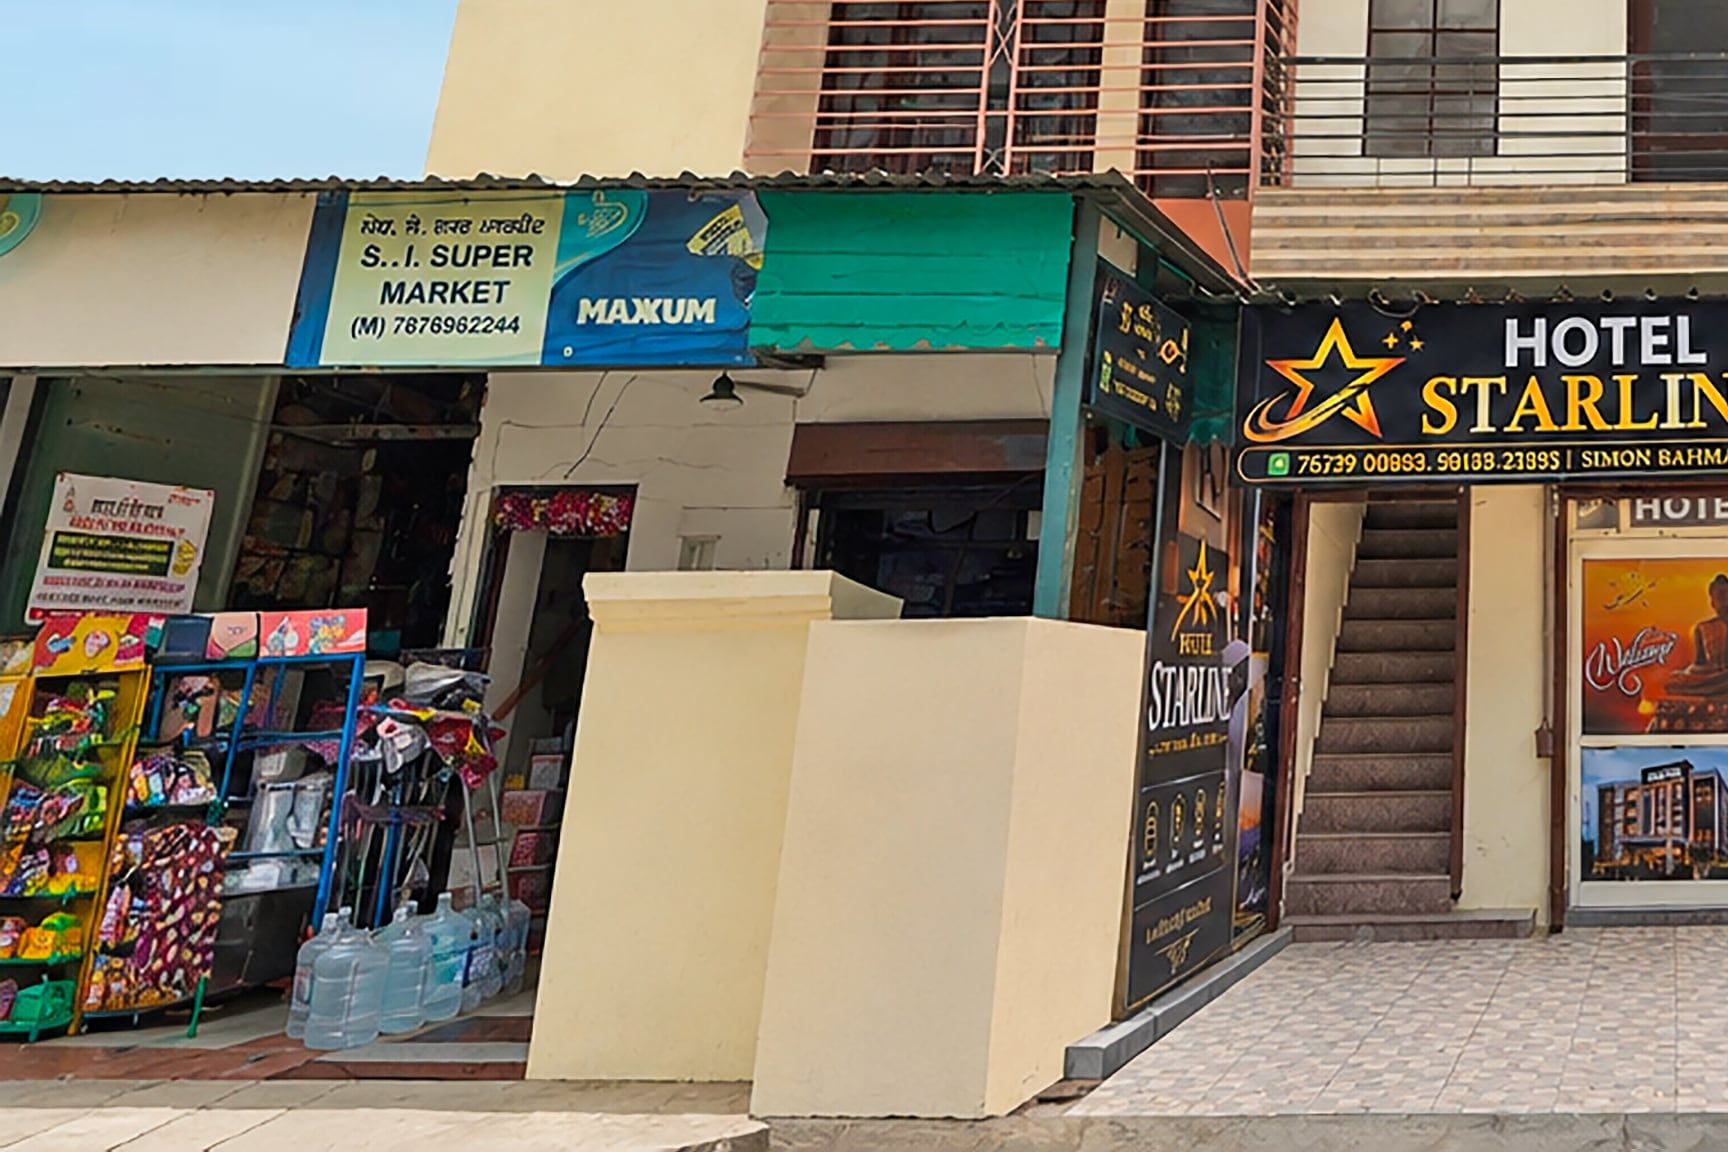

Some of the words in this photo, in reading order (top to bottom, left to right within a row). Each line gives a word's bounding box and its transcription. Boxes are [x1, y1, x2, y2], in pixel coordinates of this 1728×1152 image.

[430, 244, 534, 268] SUPER
[380, 280, 511, 305] MARKET
[351, 316, 386, 340] (M)
[1504, 315, 1708, 368] HOTEL
[1581, 449, 1650, 468] SIMON
